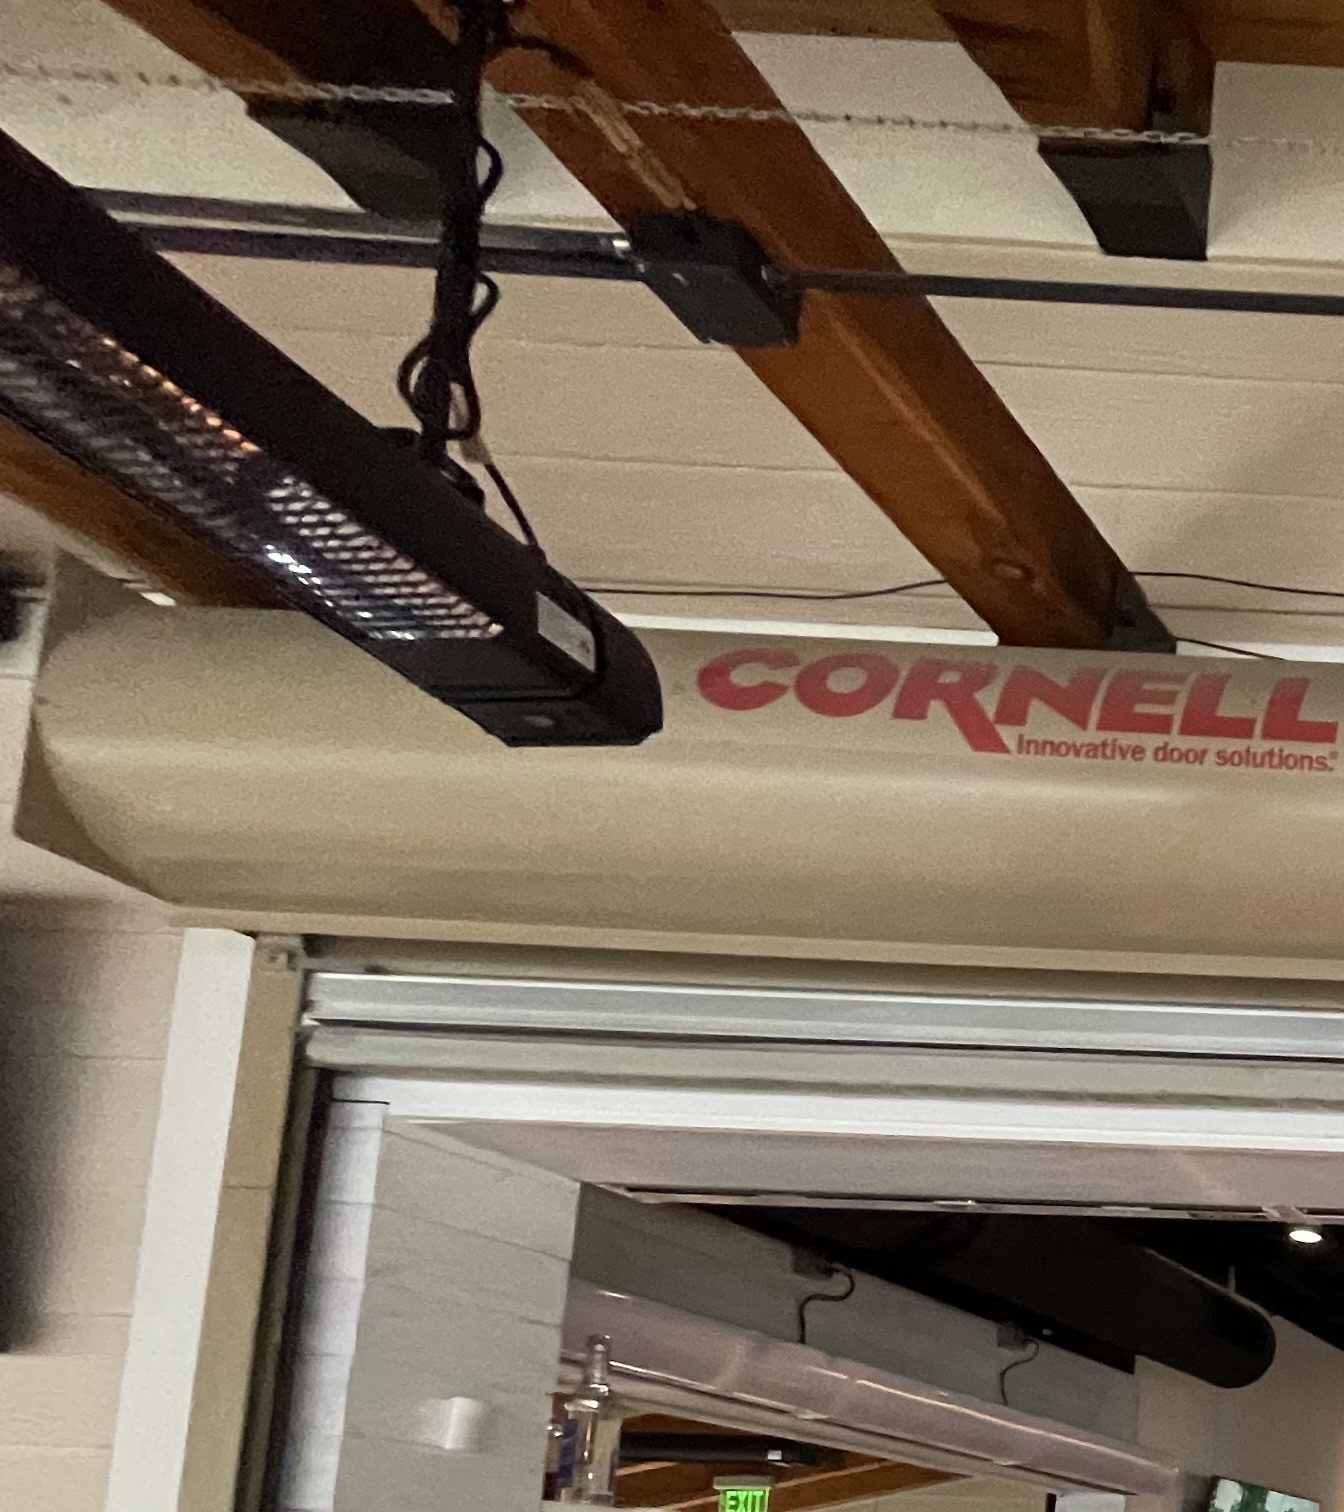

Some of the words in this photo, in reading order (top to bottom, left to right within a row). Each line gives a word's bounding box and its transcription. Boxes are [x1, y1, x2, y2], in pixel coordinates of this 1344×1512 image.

[697, 648, 1338, 754] CORNELL
[1016, 733, 1146, 762] Innovative
[1153, 742, 1205, 765] door
